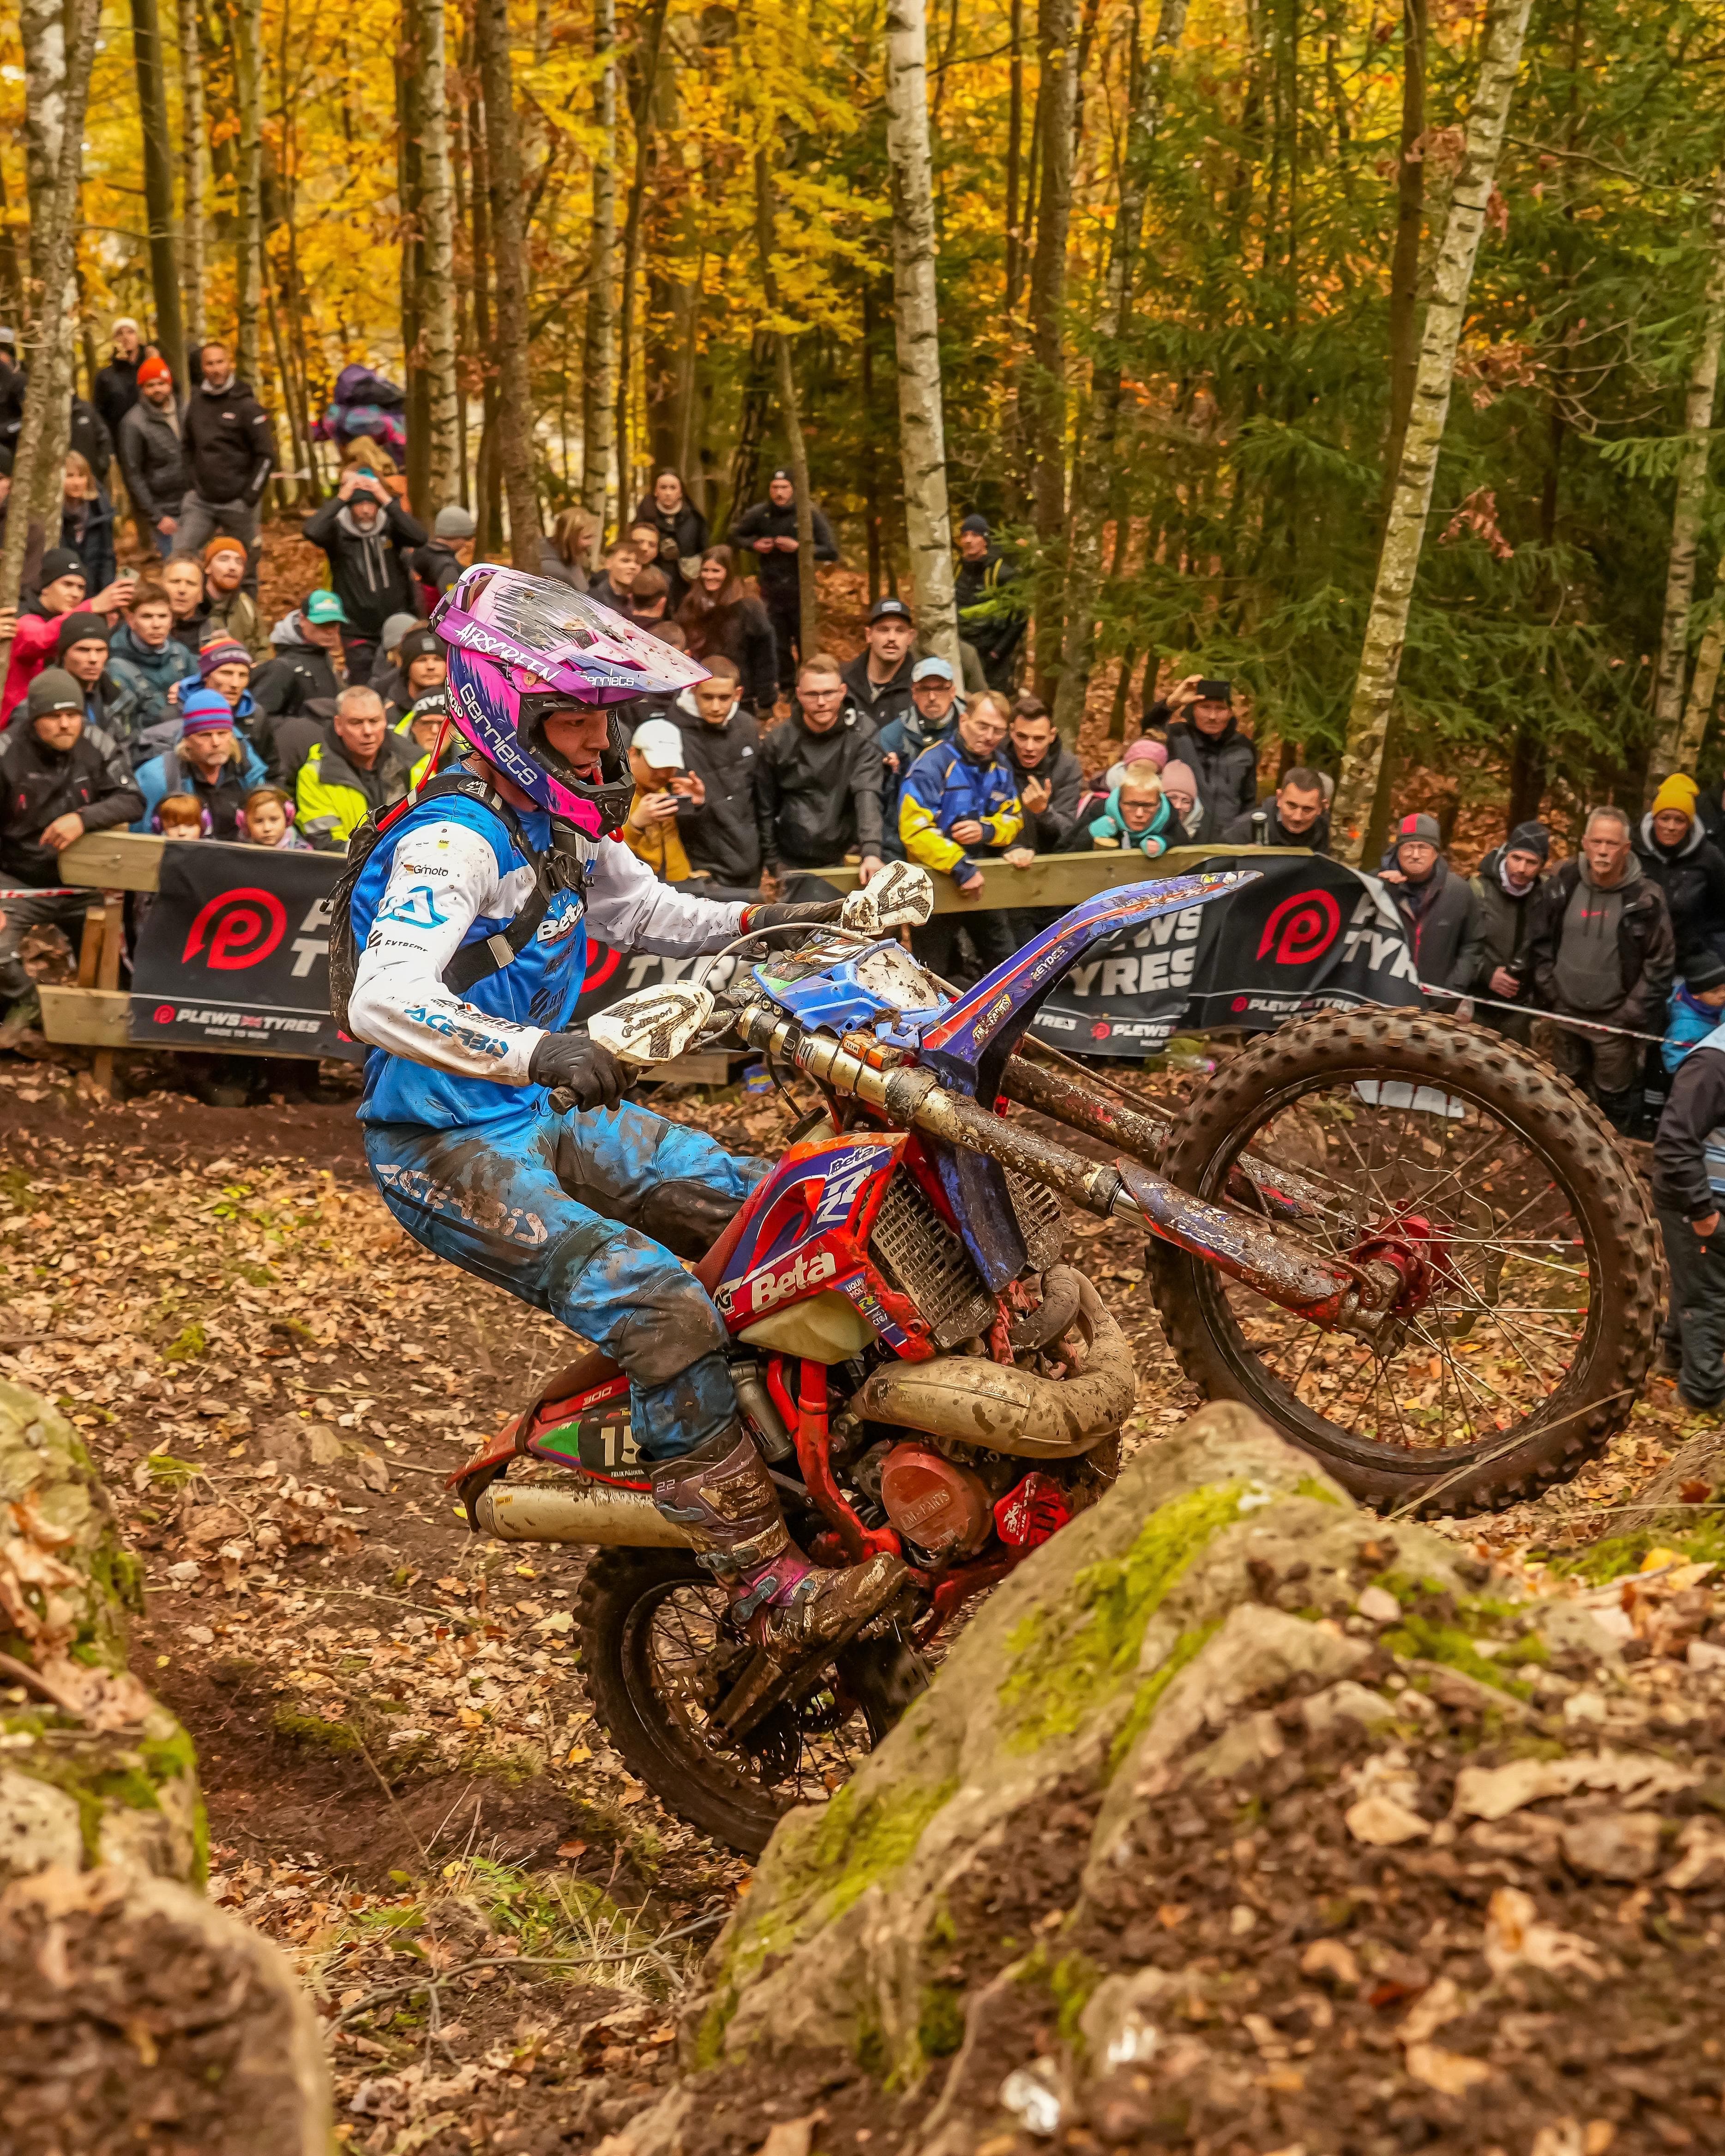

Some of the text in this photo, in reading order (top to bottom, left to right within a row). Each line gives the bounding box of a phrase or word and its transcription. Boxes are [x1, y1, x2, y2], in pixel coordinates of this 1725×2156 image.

[453, 621, 564, 682] AIRSCREEN
[176, 1007, 242, 1027] PLEWS
[264, 1016, 321, 1033] TYRES
[1111, 1024, 1171, 1037] PLEWS
[751, 1252, 836, 1313] Beta
